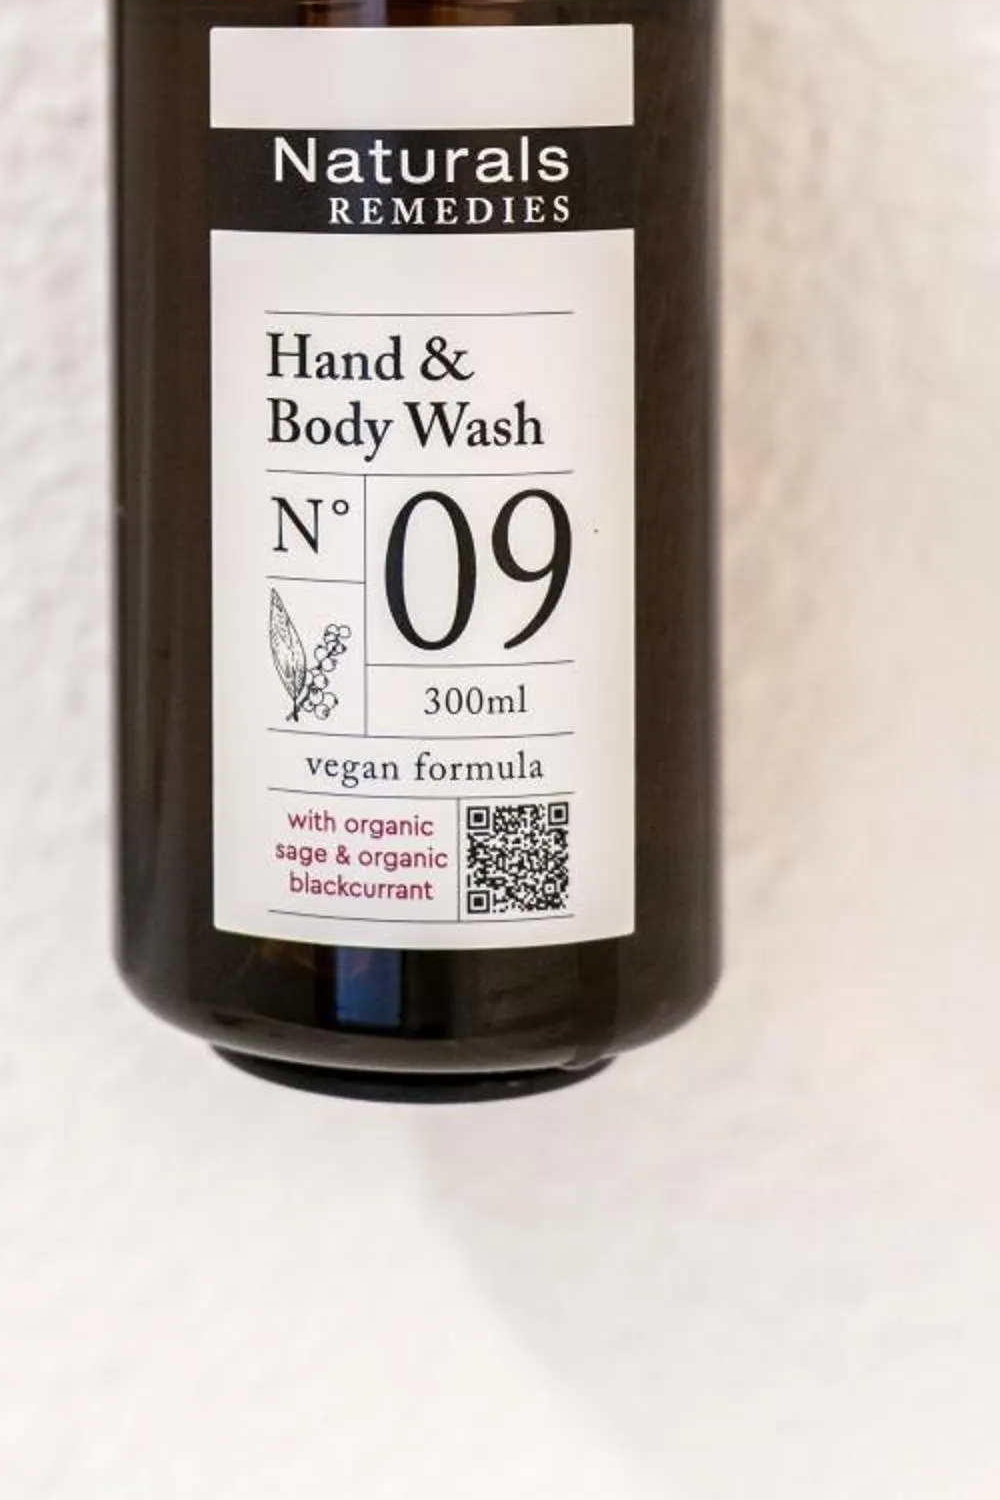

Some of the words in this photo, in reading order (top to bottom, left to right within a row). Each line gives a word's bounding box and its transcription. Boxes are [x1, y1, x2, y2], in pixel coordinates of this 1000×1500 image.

[273, 135, 570, 185] Naturals
[328, 195, 571, 226] REMEDIES
[265, 331, 404, 381] Hand
[419, 335, 474, 381] &
[266, 397, 393, 462] Body
[403, 400, 544, 448] Wash
[384, 488, 572, 651] 09
[423, 684, 528, 715] 300ml
[306, 756, 399, 788] vegan
[414, 751, 544, 781] formula
[286, 809, 337, 833] with
[345, 814, 434, 838] organic
[275, 842, 328, 866] sage
[335, 845, 352, 865] &
[358, 847, 449, 871] organic
[289, 874, 434, 901] blackcurrant
